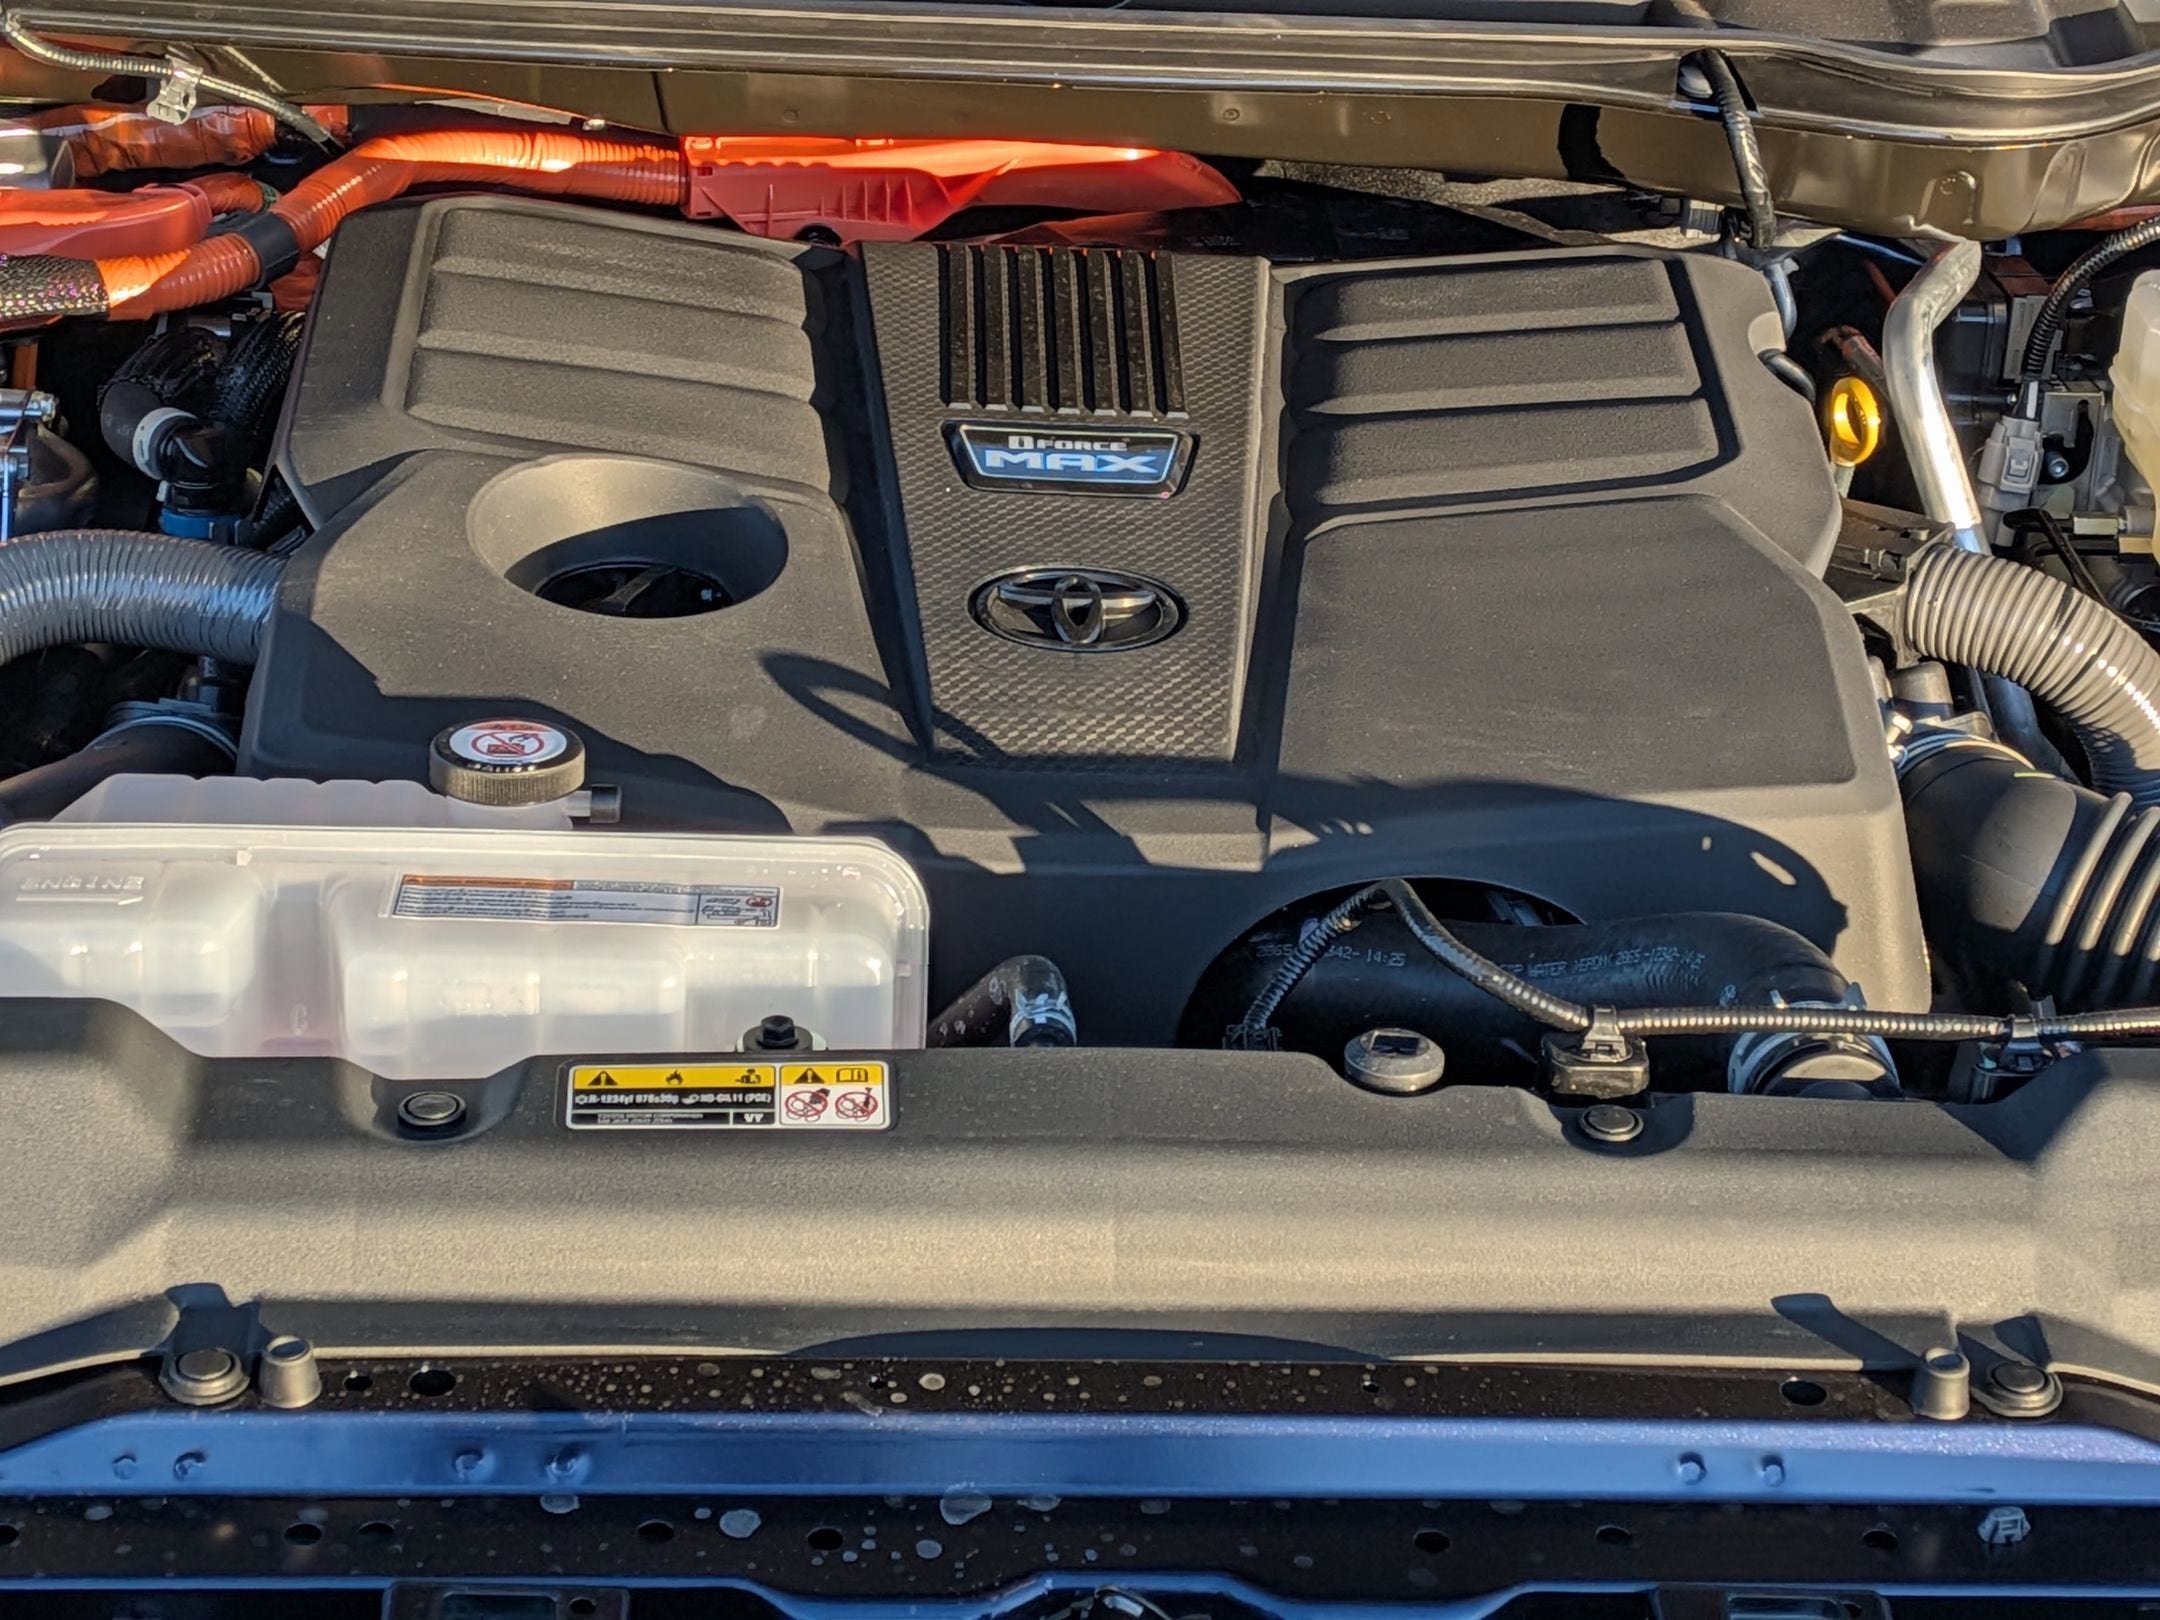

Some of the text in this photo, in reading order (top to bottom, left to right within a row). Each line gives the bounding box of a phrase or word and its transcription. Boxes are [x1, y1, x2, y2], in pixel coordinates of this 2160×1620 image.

[984, 449, 1159, 474] MAX
[20, 875, 145, 890] ENGINE
[1527, 960, 1568, 977] WATER
